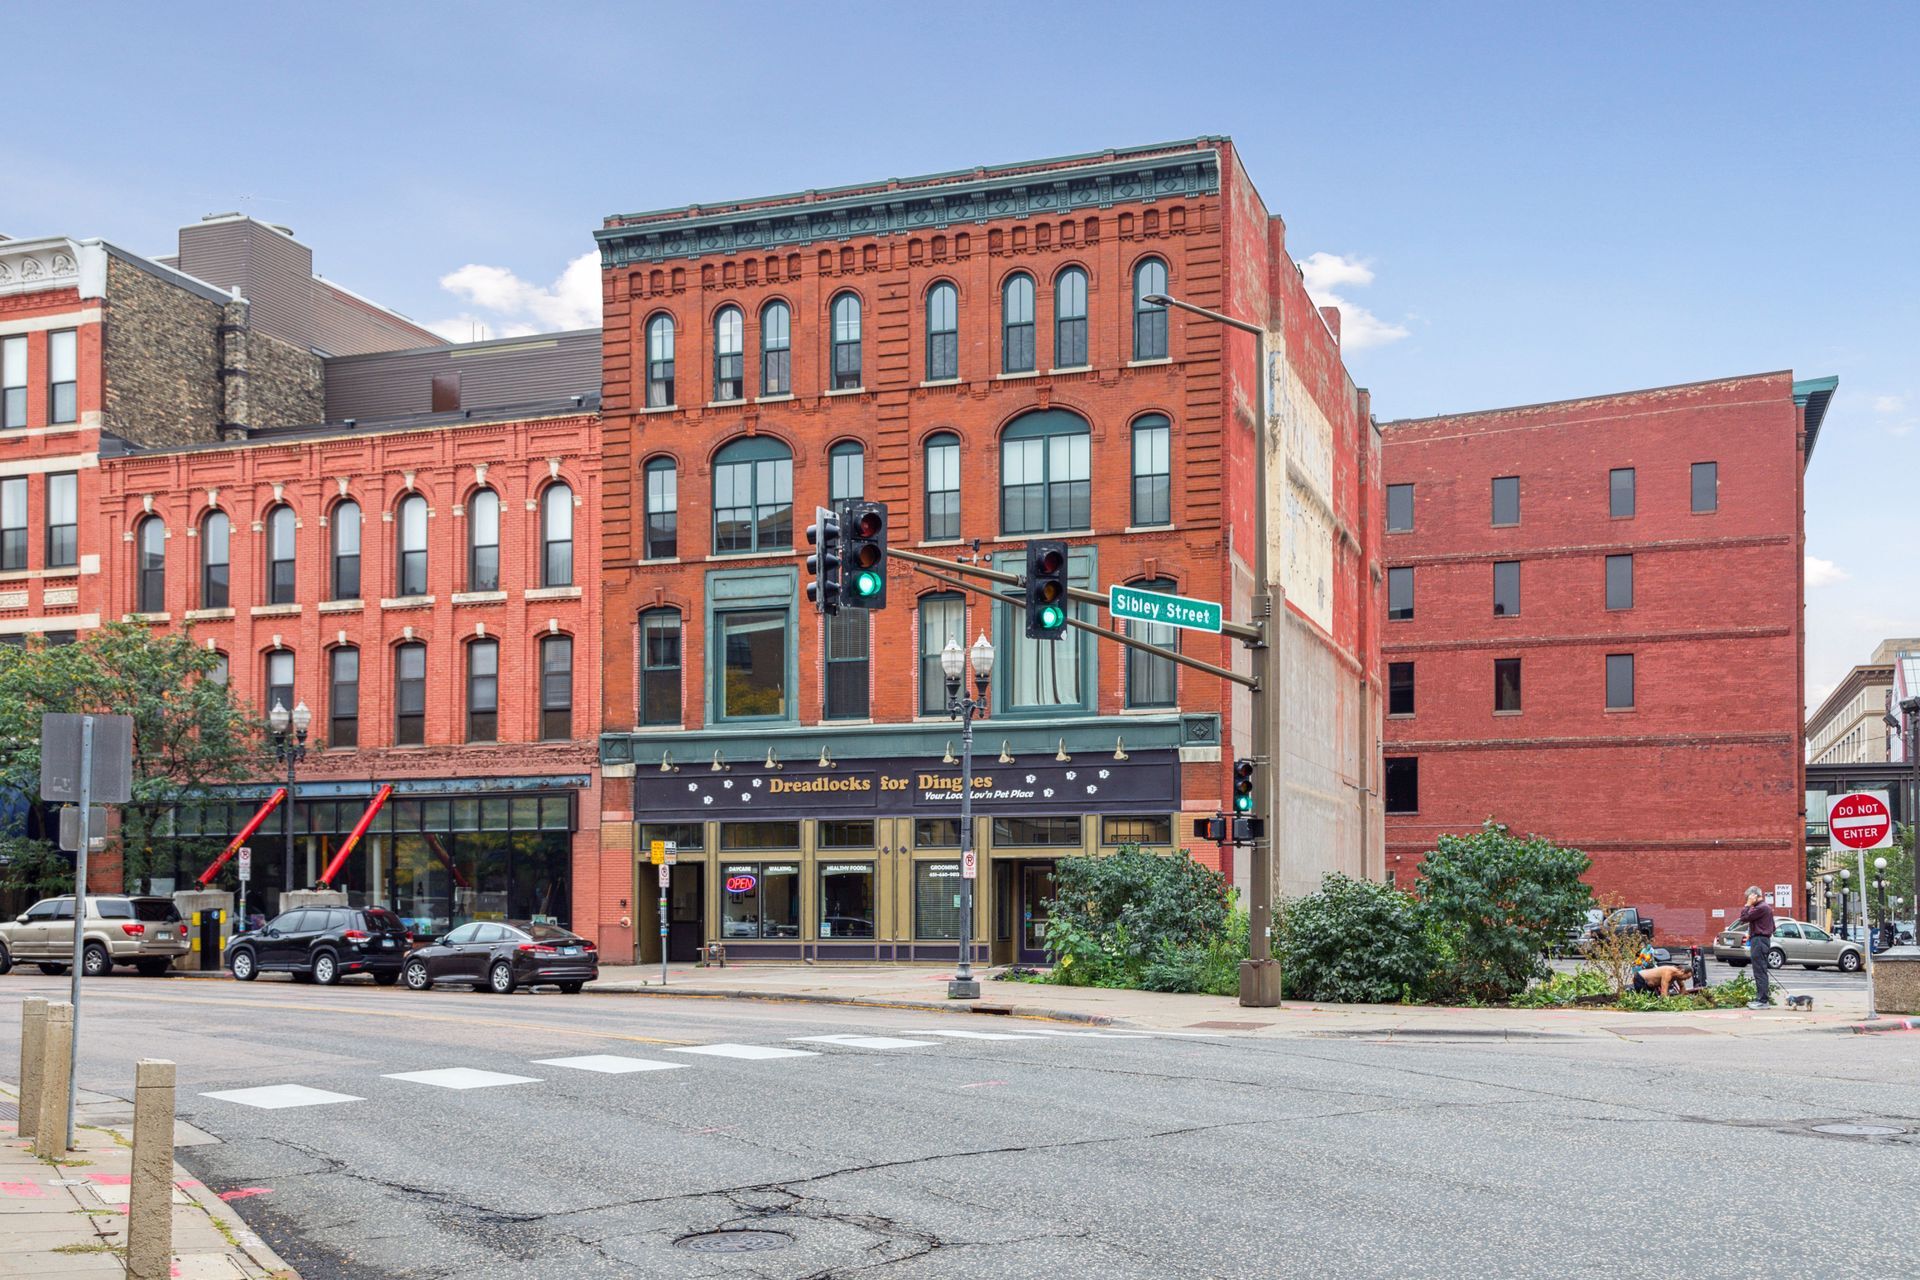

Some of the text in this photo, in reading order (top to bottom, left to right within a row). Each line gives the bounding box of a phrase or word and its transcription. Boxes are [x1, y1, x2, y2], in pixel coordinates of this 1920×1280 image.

[1117, 594, 1211, 624] Sibley Street
[769, 776, 871, 793] Dreadlocks
[880, 776, 909, 790] for
[925, 791, 945, 800] Your
[969, 790, 993, 799] Lov'n
[993, 790, 1009, 799] Pet
[1010, 789, 1035, 799] Place
[1839, 803, 1878, 816] DO NOT
[1843, 827, 1878, 840] ENTER
[727, 877, 752, 890] OPEN
